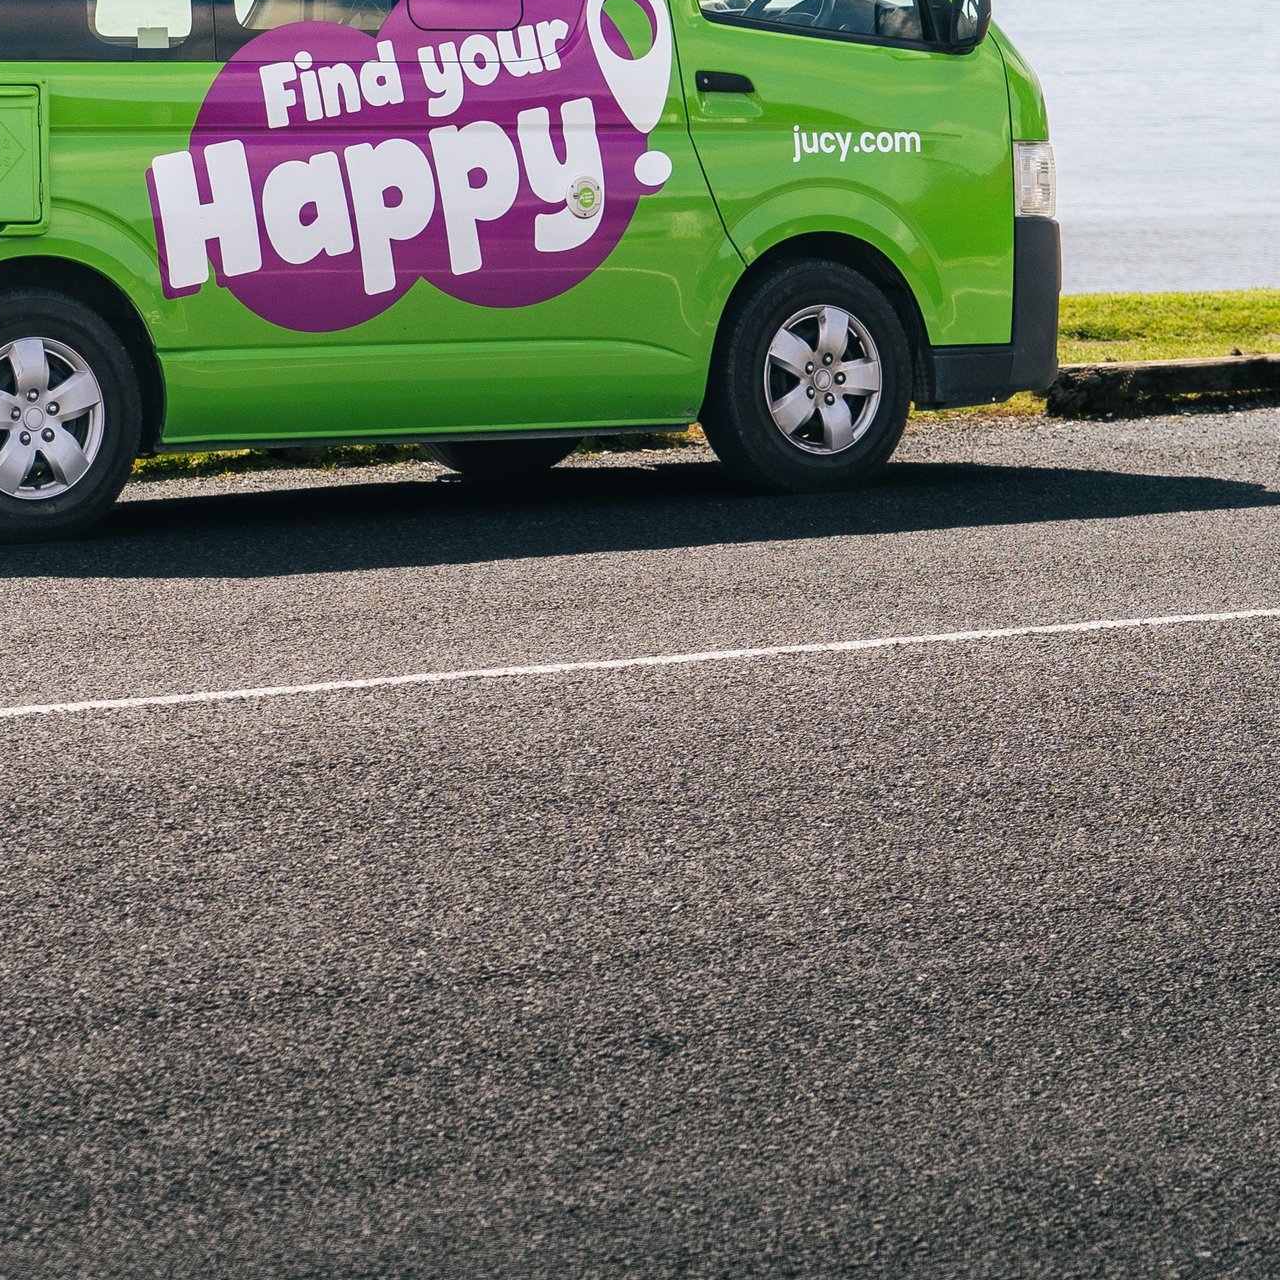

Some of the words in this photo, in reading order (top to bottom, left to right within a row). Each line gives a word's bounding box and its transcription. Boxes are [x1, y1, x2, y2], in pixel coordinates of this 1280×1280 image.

[259, 39, 405, 129] Find
[418, 18, 570, 118] your
[793, 124, 922, 163] jucy.com
